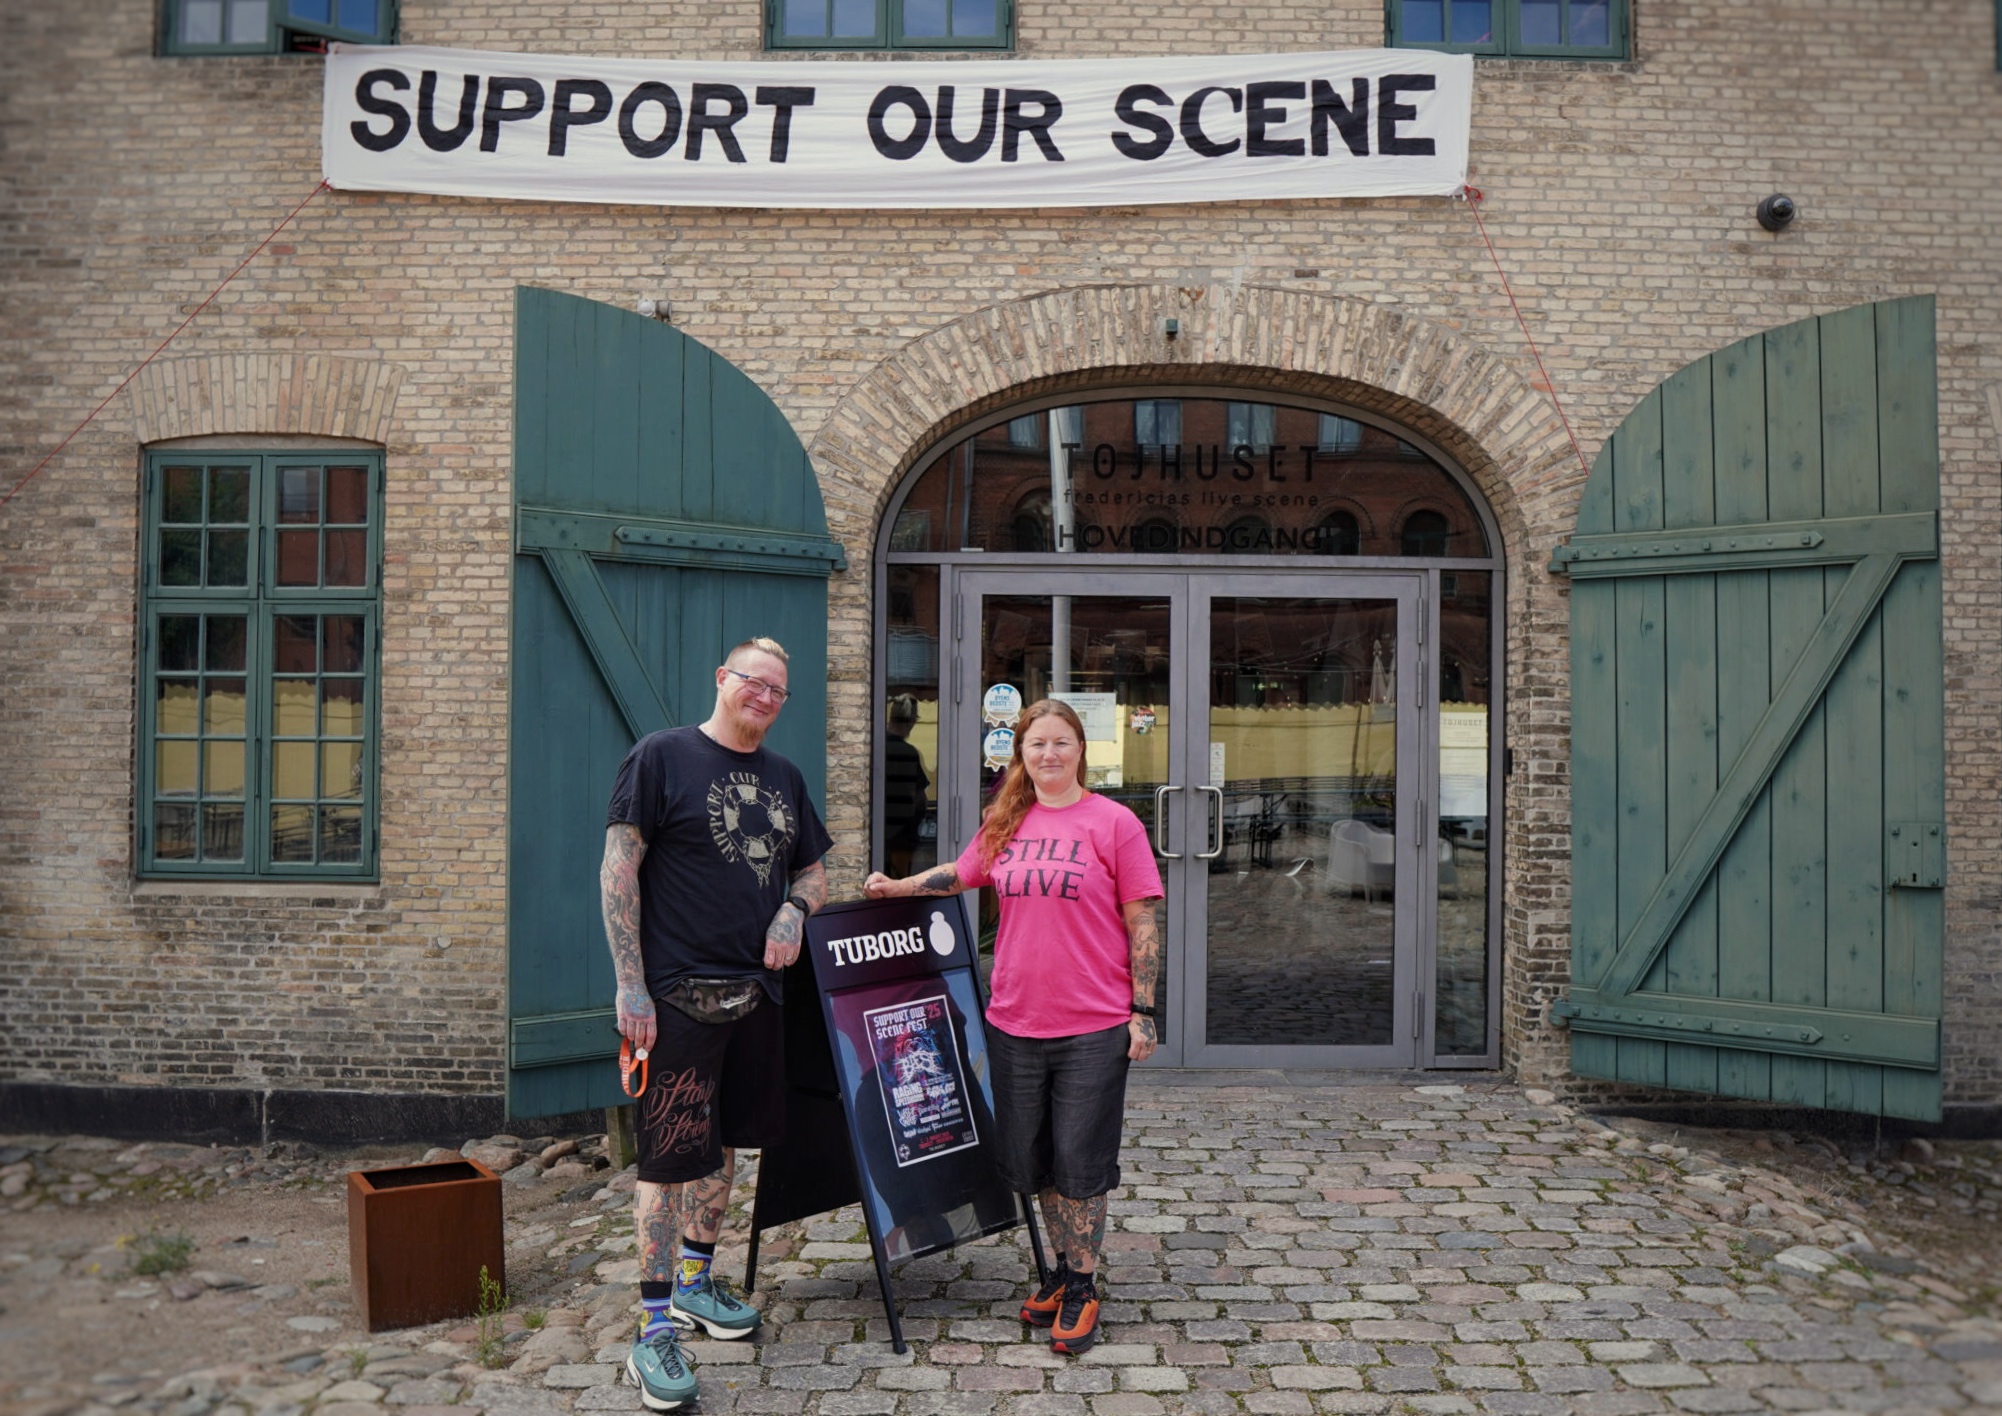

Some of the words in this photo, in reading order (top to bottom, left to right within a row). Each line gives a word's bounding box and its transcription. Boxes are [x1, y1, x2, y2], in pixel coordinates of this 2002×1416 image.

[350, 68, 815, 163] SUPPORT
[867, 85, 1065, 163] OUR
[1111, 74, 1436, 161] SCENE
[1063, 489, 1190, 505] fredericias
[1202, 491, 1242, 506] live
[1255, 493, 1319, 507] scene
[1059, 524, 1322, 550] HOVEDINDGANG
[707, 779, 736, 862] SUPPORT
[729, 771, 760, 787] OUR
[1000, 838, 1087, 866] STILL
[827, 926, 925, 967] TUBORG
[873, 1008, 909, 1027] SUPPORT
[909, 1005, 926, 1020] OUR
[876, 1023, 904, 1040] SCENE
[905, 1017, 927, 1034] FEST
